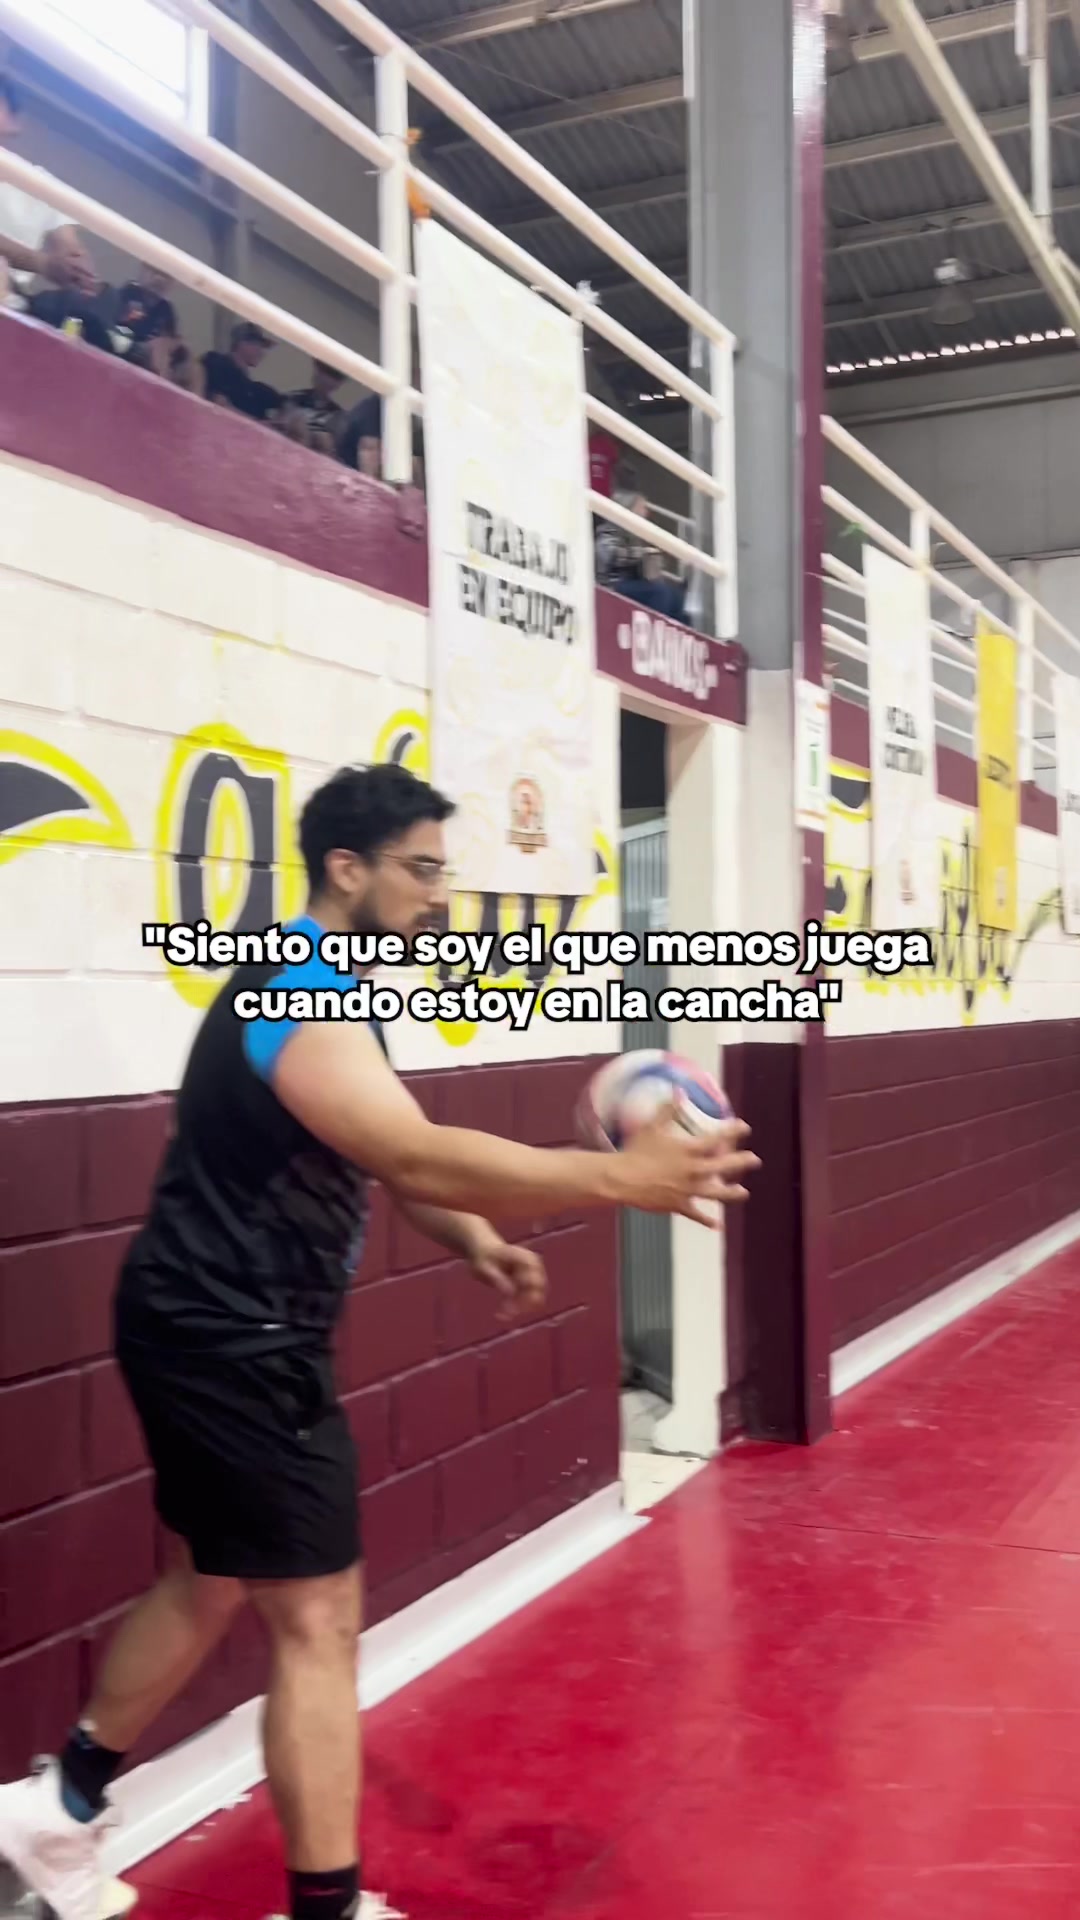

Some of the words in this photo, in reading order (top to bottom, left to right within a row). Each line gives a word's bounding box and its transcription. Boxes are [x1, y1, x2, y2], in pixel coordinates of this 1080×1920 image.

[465, 501, 569, 585] TRABAJO
[457, 562, 488, 618] EN
[495, 576, 574, 646] EQUIPO
